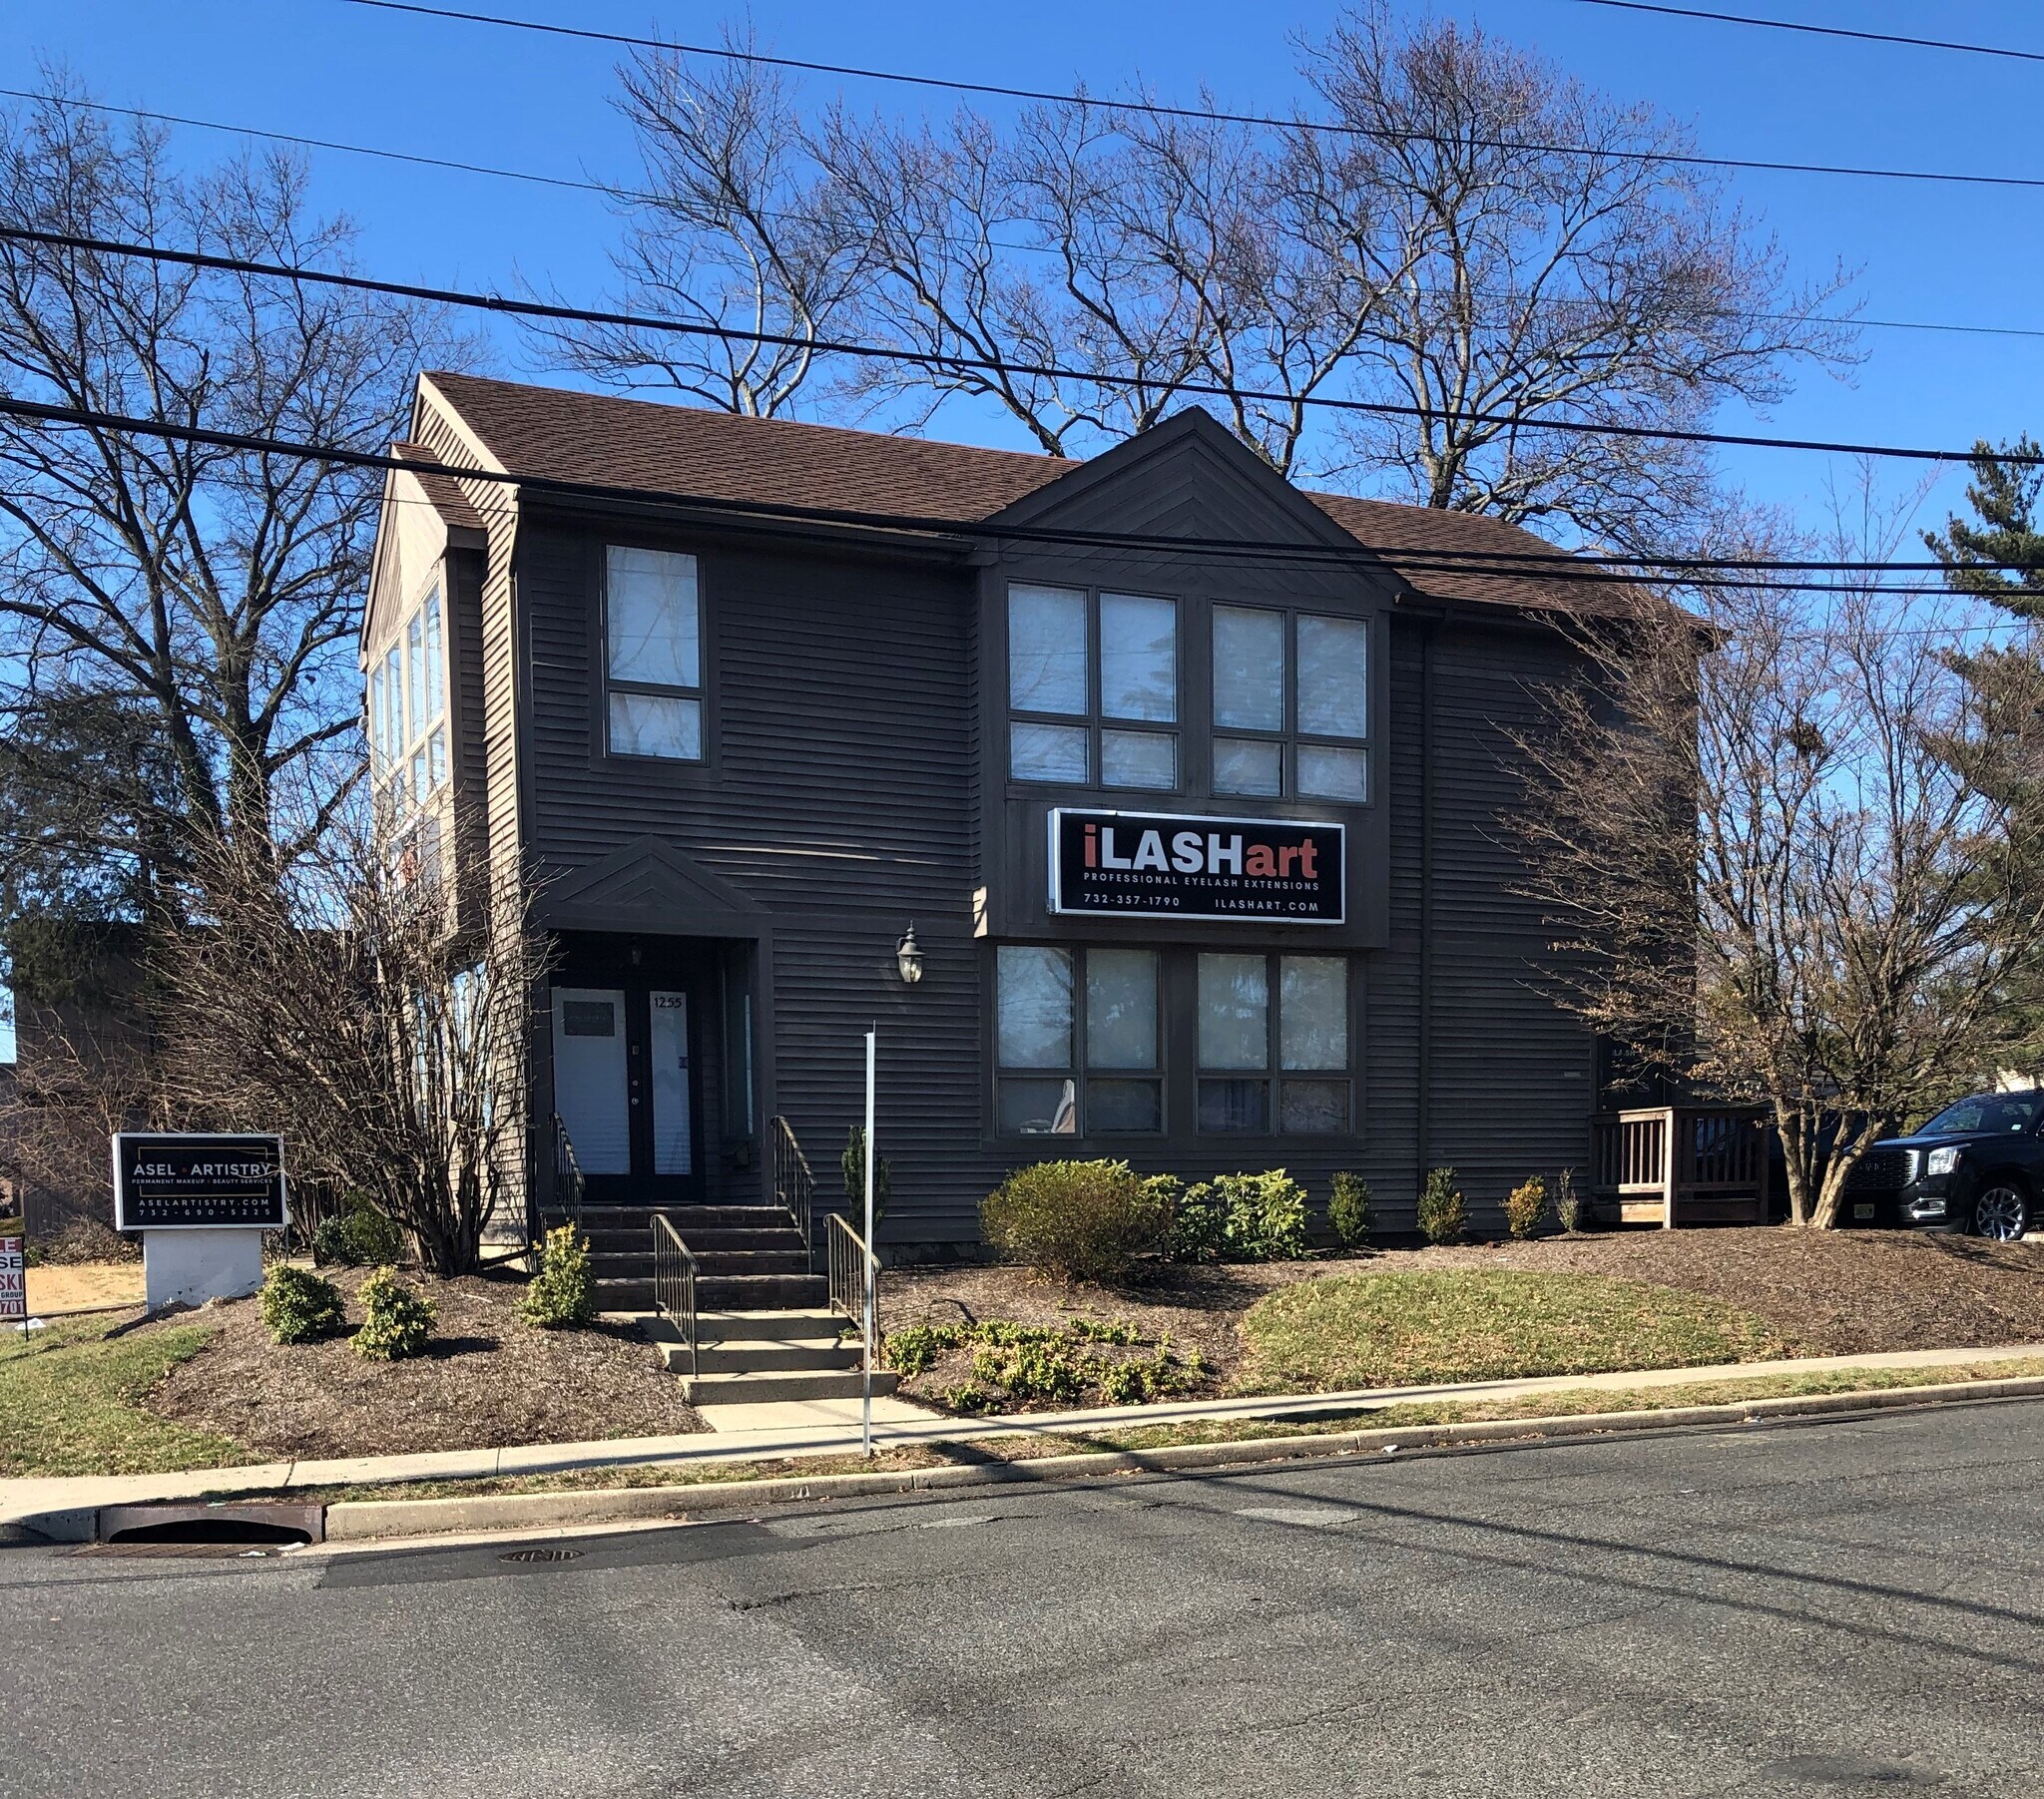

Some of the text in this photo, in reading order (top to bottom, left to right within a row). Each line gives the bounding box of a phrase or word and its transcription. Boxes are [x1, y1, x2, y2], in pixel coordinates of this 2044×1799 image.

[1084, 872, 1319, 891] PROFESSIONAL EYELASH EXTENSIONS
[1084, 893, 1319, 912] 732-357-1790 ILASHART.COM
[654, 997, 682, 1009] 1255
[133, 1163, 271, 1176] ASEL ARTISTRY
[0, 1300, 24, 1314] 701
